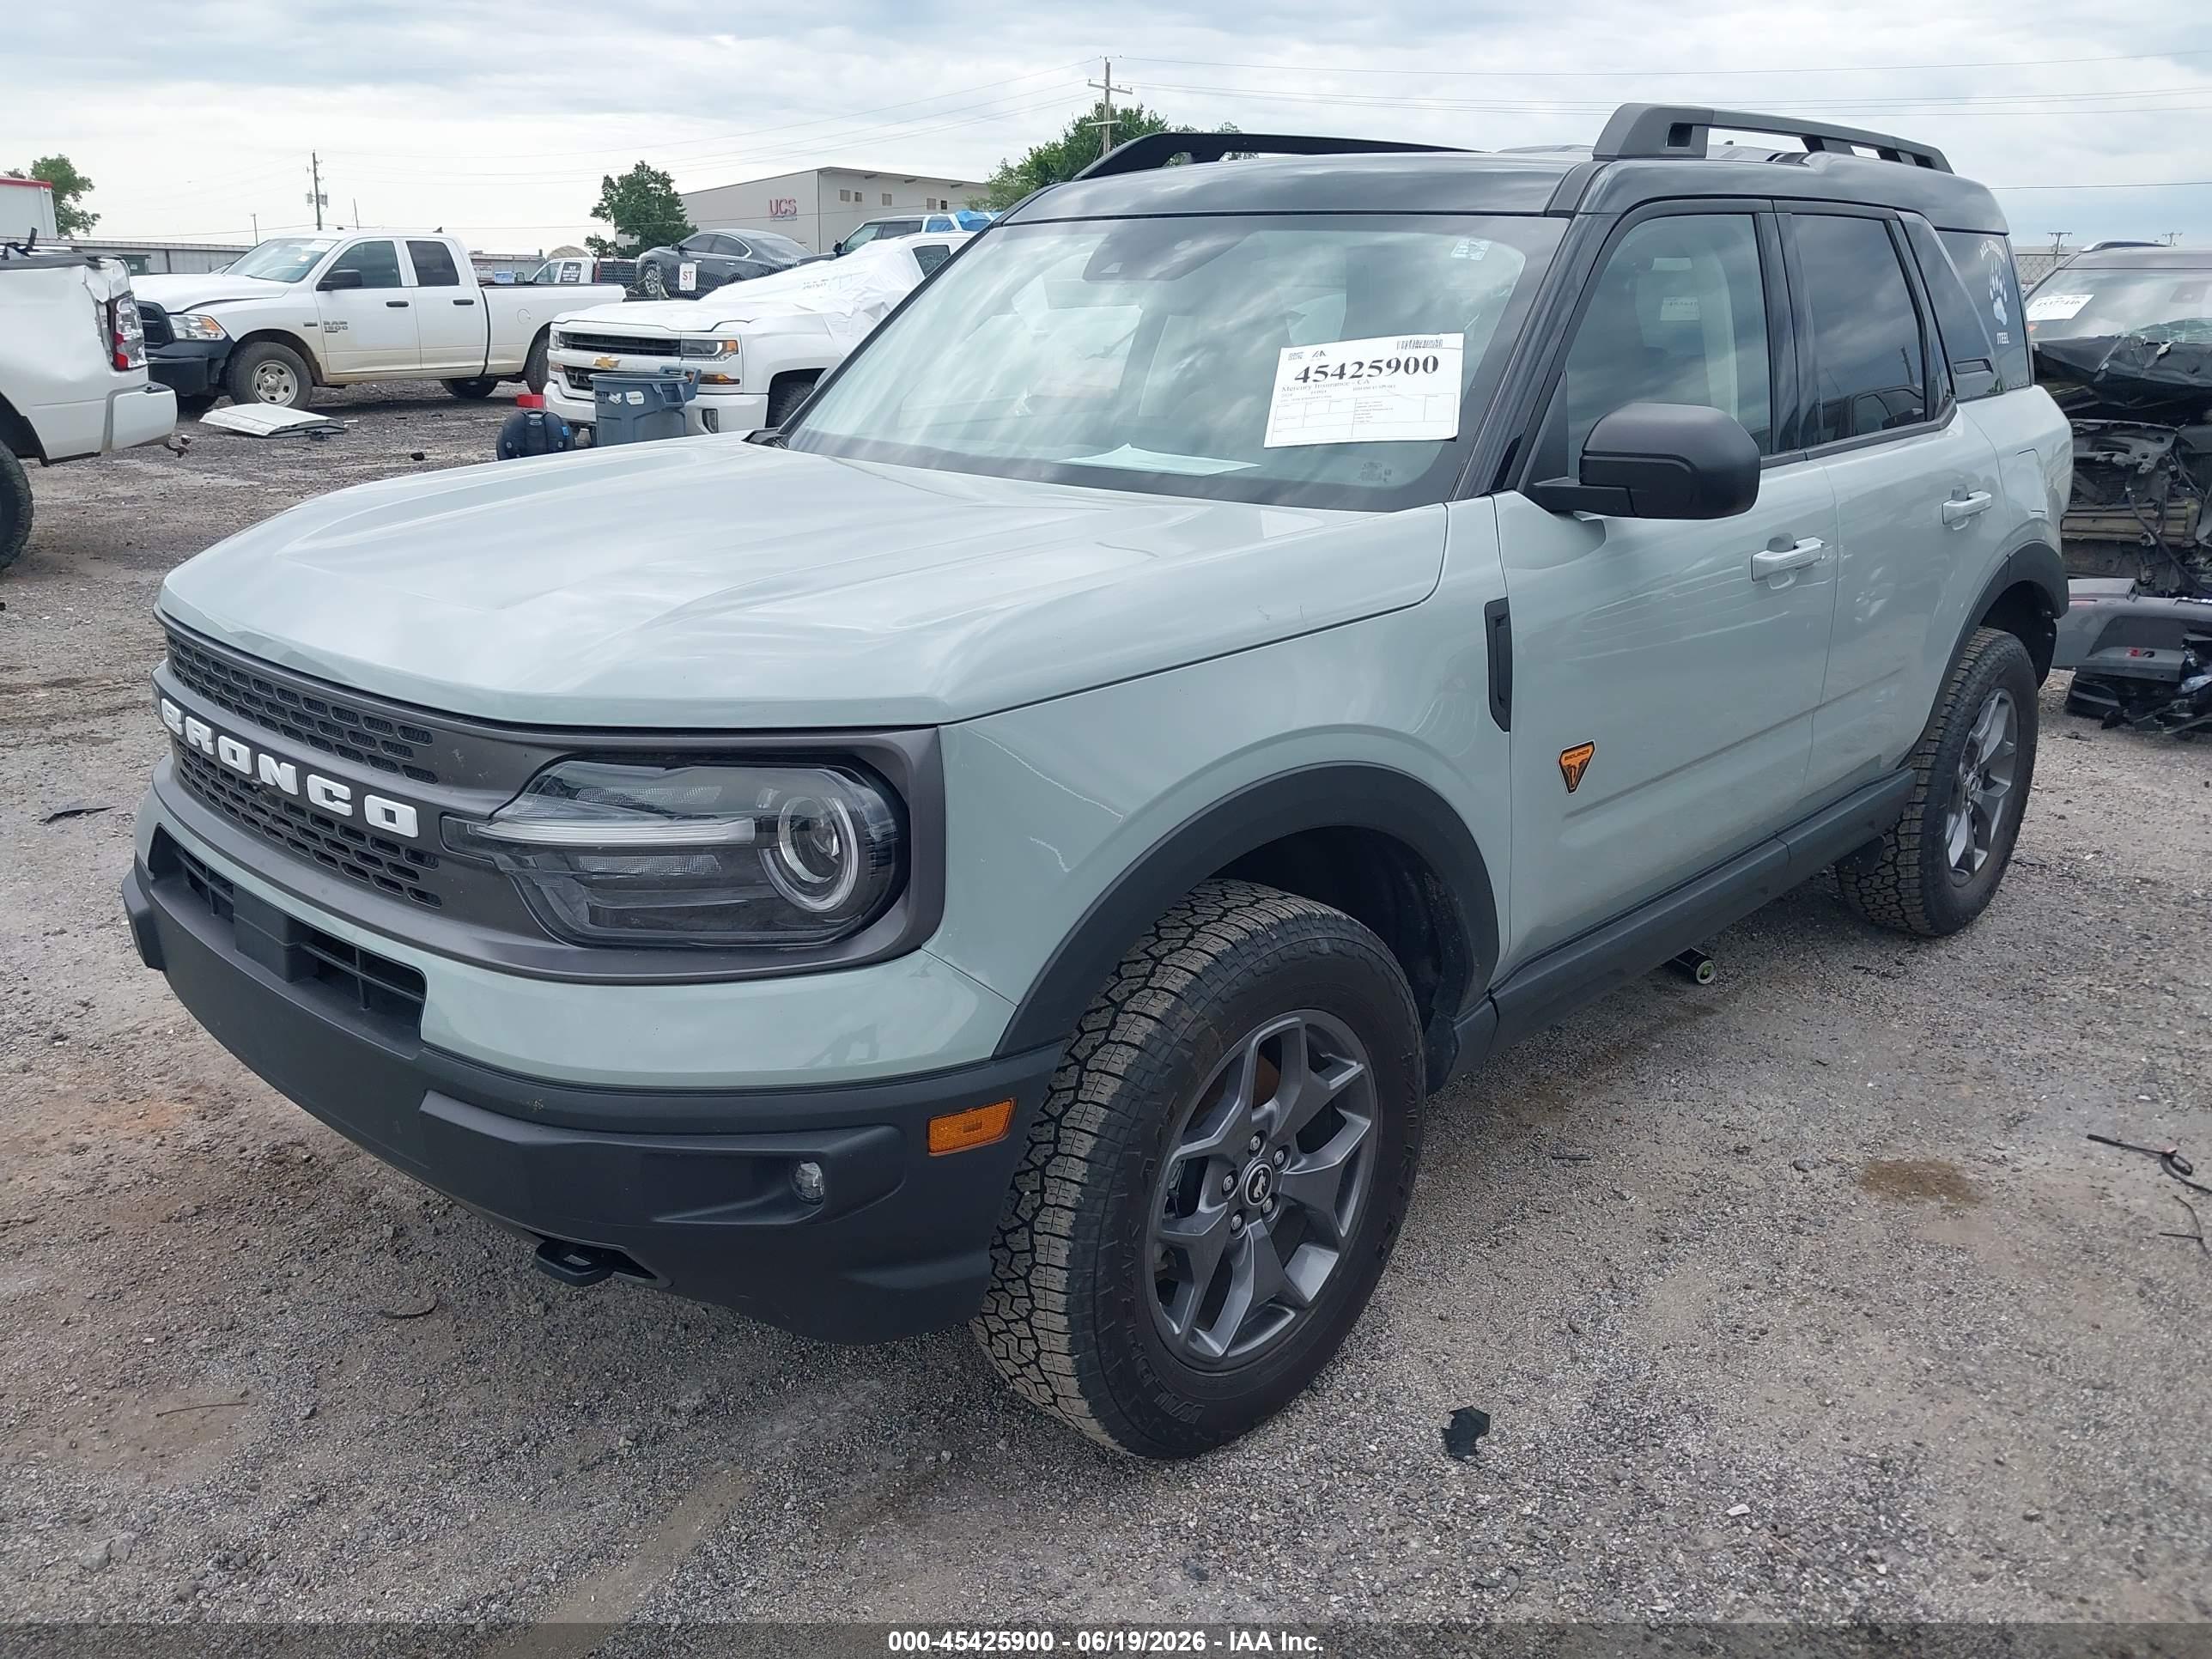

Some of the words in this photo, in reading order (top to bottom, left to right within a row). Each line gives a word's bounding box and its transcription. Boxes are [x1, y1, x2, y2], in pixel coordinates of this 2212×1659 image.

[769, 198, 797, 215] UCS
[1294, 356, 1439, 383] 45425900
[1280, 384, 1313, 392] Mercury
[161, 698, 419, 838] BRONCO
